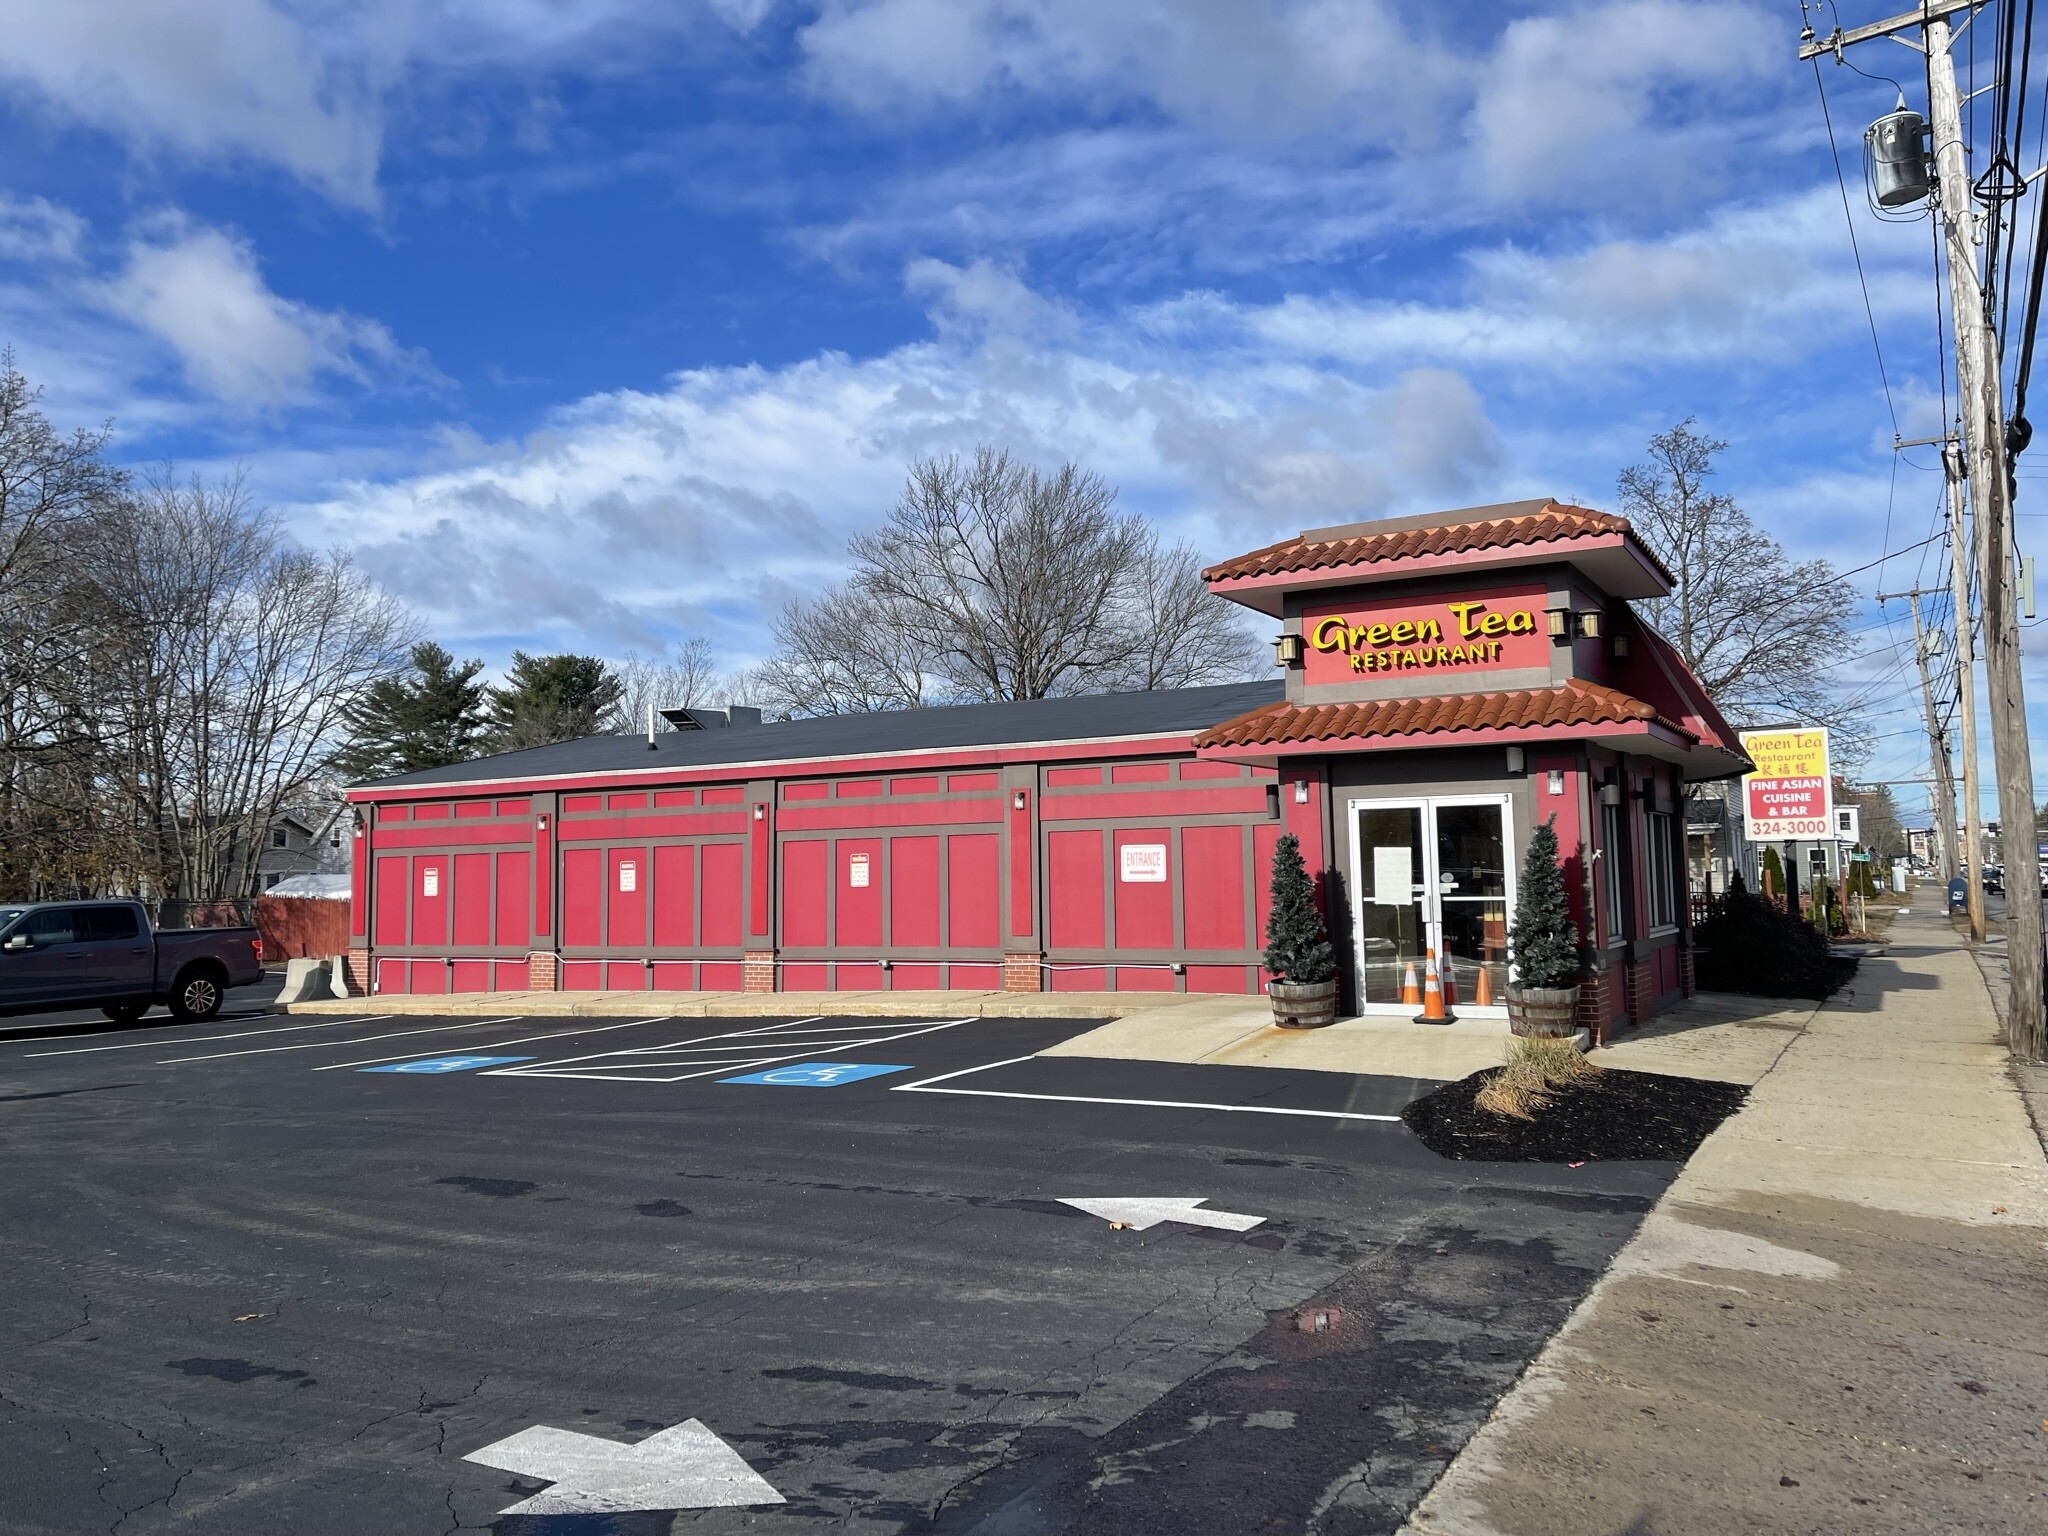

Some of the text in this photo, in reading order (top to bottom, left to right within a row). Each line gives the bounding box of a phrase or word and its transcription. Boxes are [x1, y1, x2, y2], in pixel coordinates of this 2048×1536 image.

[1311, 601, 1535, 652] Green Tea
[1350, 641, 1500, 670] RESTAURANT
[1746, 734, 1823, 752] Green Tea
[1754, 752, 1815, 763] Restaurant
[1751, 779, 1821, 791] FINE ASIAN
[1763, 792, 1811, 803] CUISINE
[1768, 806, 1808, 816] & BAR
[1753, 820, 1826, 835] 324-3000
[1126, 852, 1161, 867] ENTRANCE
